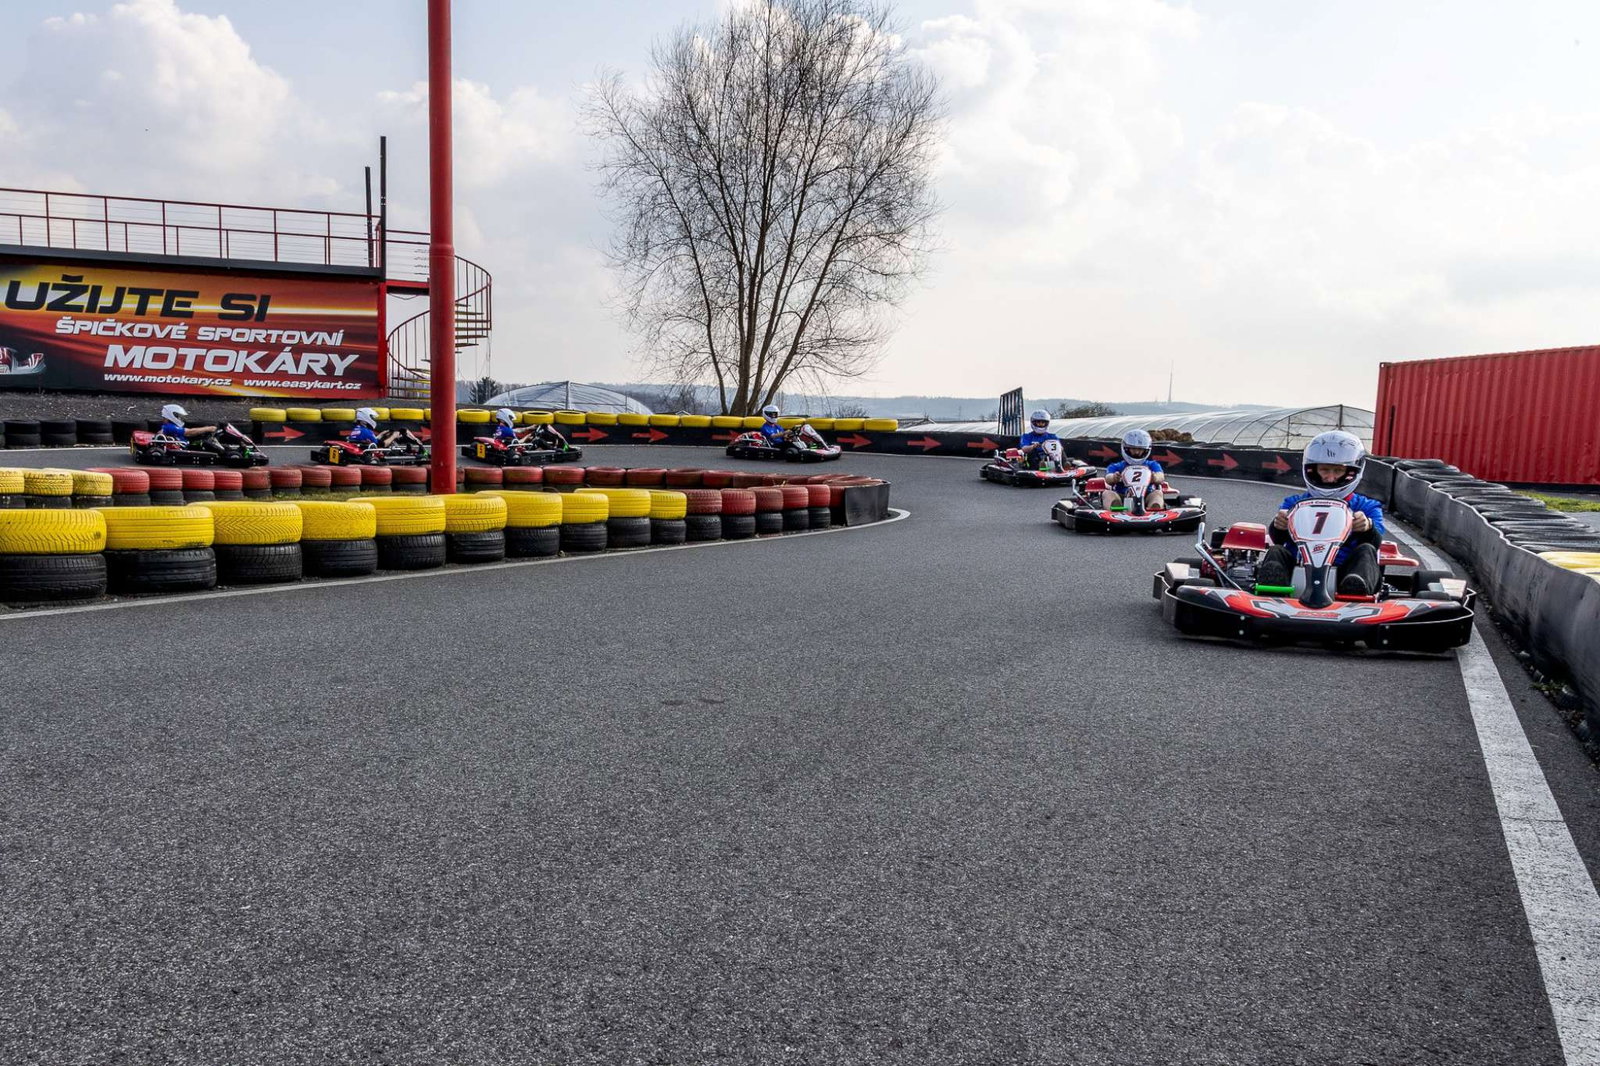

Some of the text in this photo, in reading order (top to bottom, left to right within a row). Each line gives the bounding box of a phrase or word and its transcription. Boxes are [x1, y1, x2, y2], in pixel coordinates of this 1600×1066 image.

[4, 274, 271, 322] UŽIJTE SI
[55, 316, 344, 346] ŠPIČKOVÉ SPORTOVNÍ
[104, 344, 360, 376] MOTOKÁRY
[104, 373, 361, 391] www.motokary.cz www.easykart.cz
[1050, 443, 1057, 451] 3
[1131, 471, 1143, 482] 2
[1312, 511, 1330, 535] 1
